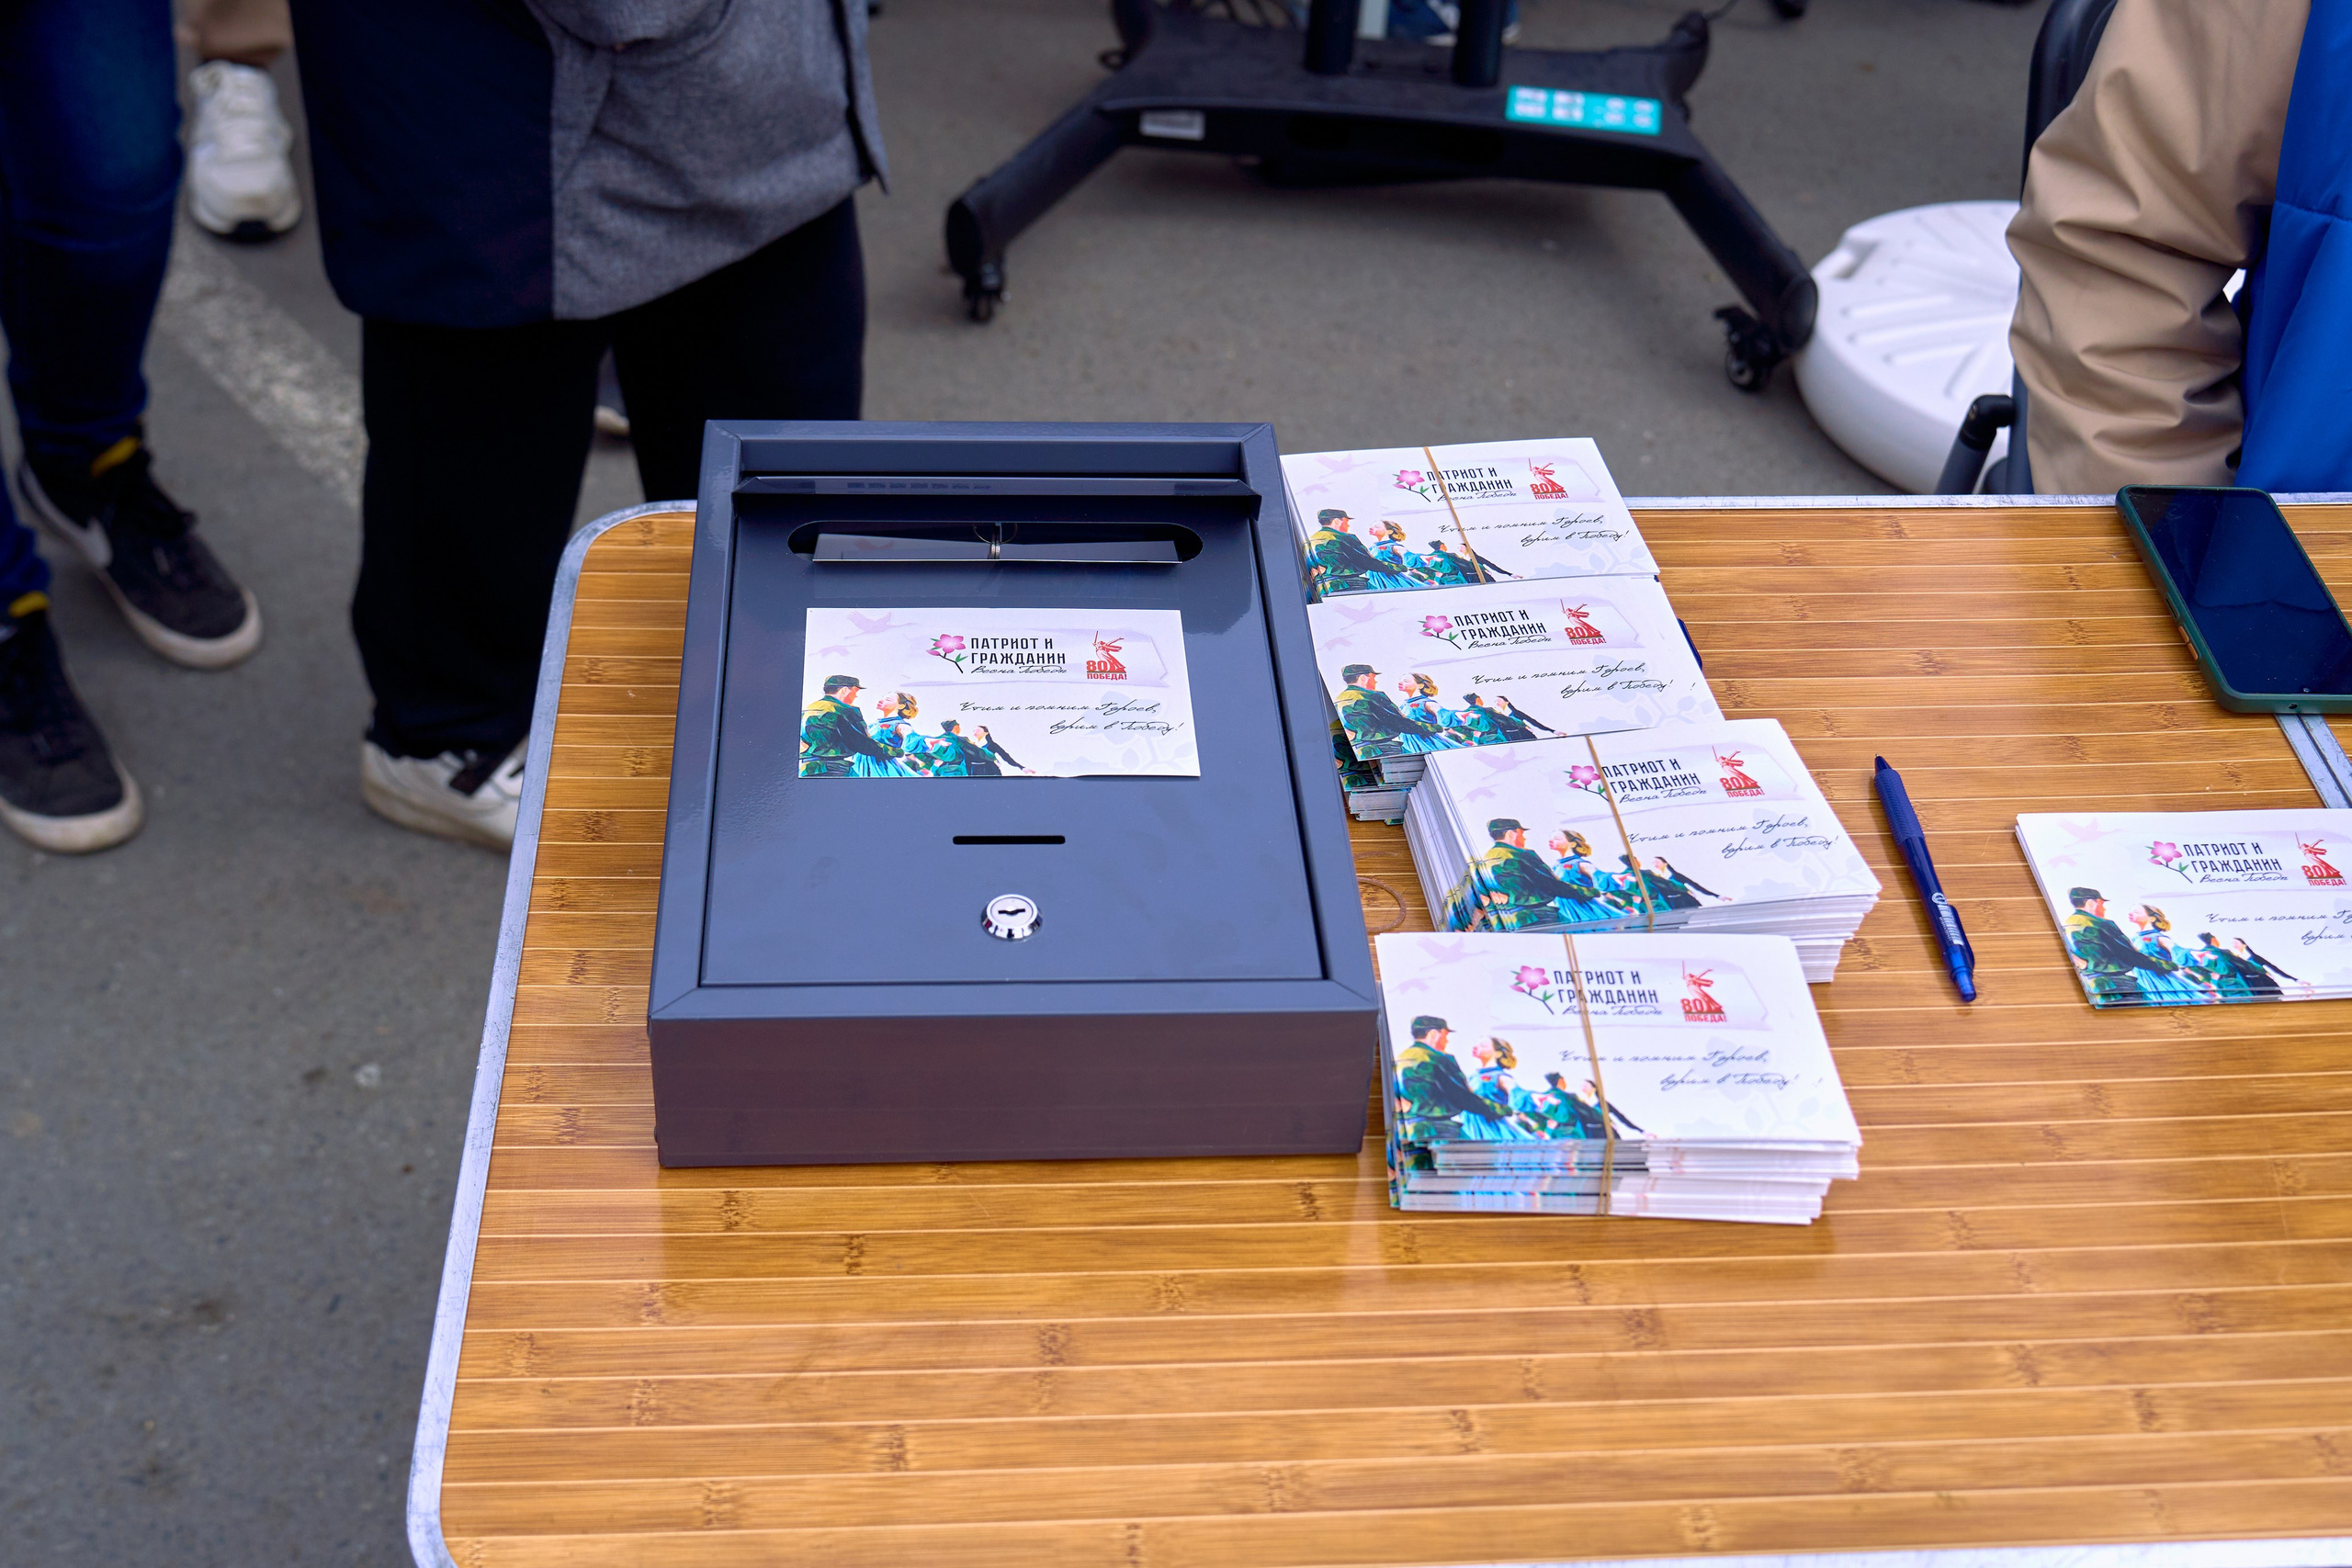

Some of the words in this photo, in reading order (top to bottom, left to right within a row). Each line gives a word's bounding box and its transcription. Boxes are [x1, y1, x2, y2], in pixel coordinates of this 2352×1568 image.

[1488, 467, 1498, 478] И
[1453, 611, 1516, 626] ПАТРИОТ
[1519, 610, 1530, 621] И
[1460, 622, 1547, 640] ГРАЖДАНИН
[970, 637, 1039, 649] ПАТРИОТ
[1045, 637, 1053, 649] И
[1570, 637, 1607, 646] ПОБЕДА!
[970, 652, 1066, 665] ГРАЖДАНИН
[1087, 672, 1127, 681] ПОБЕДА!
[1601, 760, 1667, 778] ПАТРИОТ
[1669, 759, 1681, 771] И
[1610, 773, 1701, 794] ГРАЖДАНИН
[1726, 789, 1765, 798] ПОБЕДА!
[2183, 842, 2247, 857] ПАТРИОТ
[2251, 842, 2263, 854] И
[2191, 858, 2282, 874] ГРАЖДАНИН
[2308, 878, 2347, 886] ПОБЕДА!
[1631, 971, 1642, 984] И
